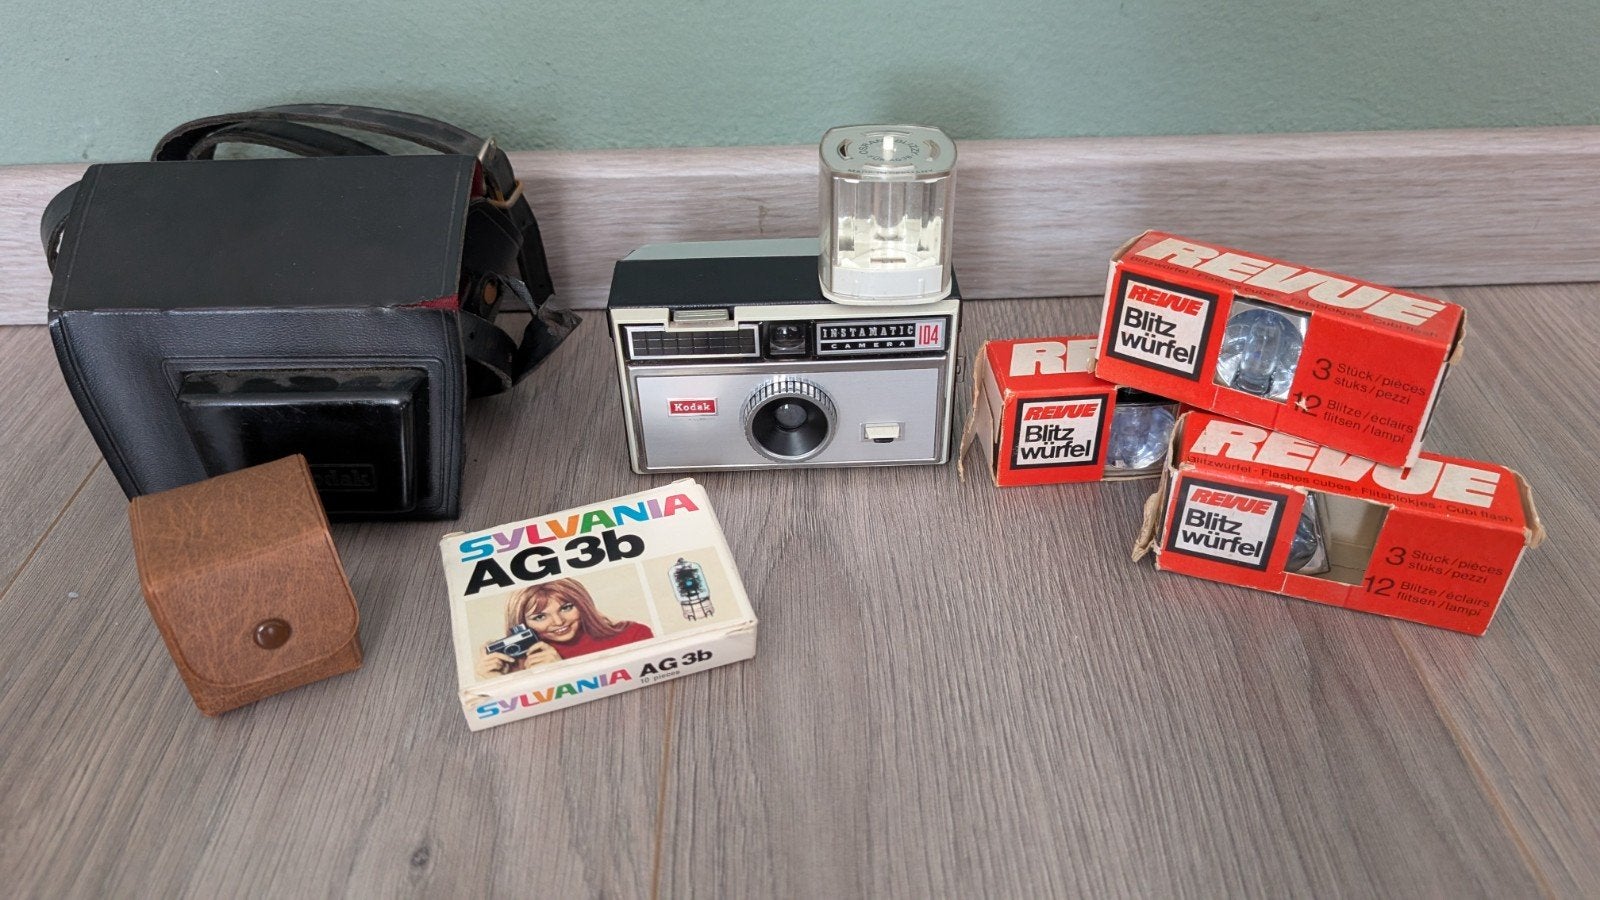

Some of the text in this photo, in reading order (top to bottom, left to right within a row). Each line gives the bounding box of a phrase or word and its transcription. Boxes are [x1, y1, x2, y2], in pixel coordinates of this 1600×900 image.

[1135, 237, 1447, 325] REVUE
[1127, 284, 1204, 316] REVUE
[821, 325, 939, 345] INSTAMATIC 104
[1123, 306, 1177, 338] Blitz
[831, 341, 906, 349] CAMERA
[1120, 330, 1198, 365] würfel
[1312, 358, 1332, 381] 3
[674, 402, 711, 413] Kodak
[1024, 403, 1098, 421] REVUE
[1293, 391, 1322, 418] 12
[1025, 424, 1074, 443] Blitz
[1021, 439, 1091, 460] würfel
[1190, 419, 1500, 508] REVUE
[313, 470, 369, 486] odak
[1190, 487, 1271, 515] REVUE
[1261, 468, 1310, 483] Flashes
[1313, 478, 1351, 492] cubes
[1361, 487, 1436, 509] Flitsblokjes
[1446, 505, 1477, 517] Cubi
[1481, 511, 1513, 522] flash
[459, 493, 699, 562] SYLVANIA
[1185, 508, 1242, 536] Blitz
[1181, 529, 1264, 558] würfel
[1385, 546, 1406, 566] 3
[464, 530, 645, 596] AG 3b
[1365, 575, 1395, 597] 12
[476, 650, 713, 719] SYLVANIA AG 3b
[653, 670, 680, 681] pieces
